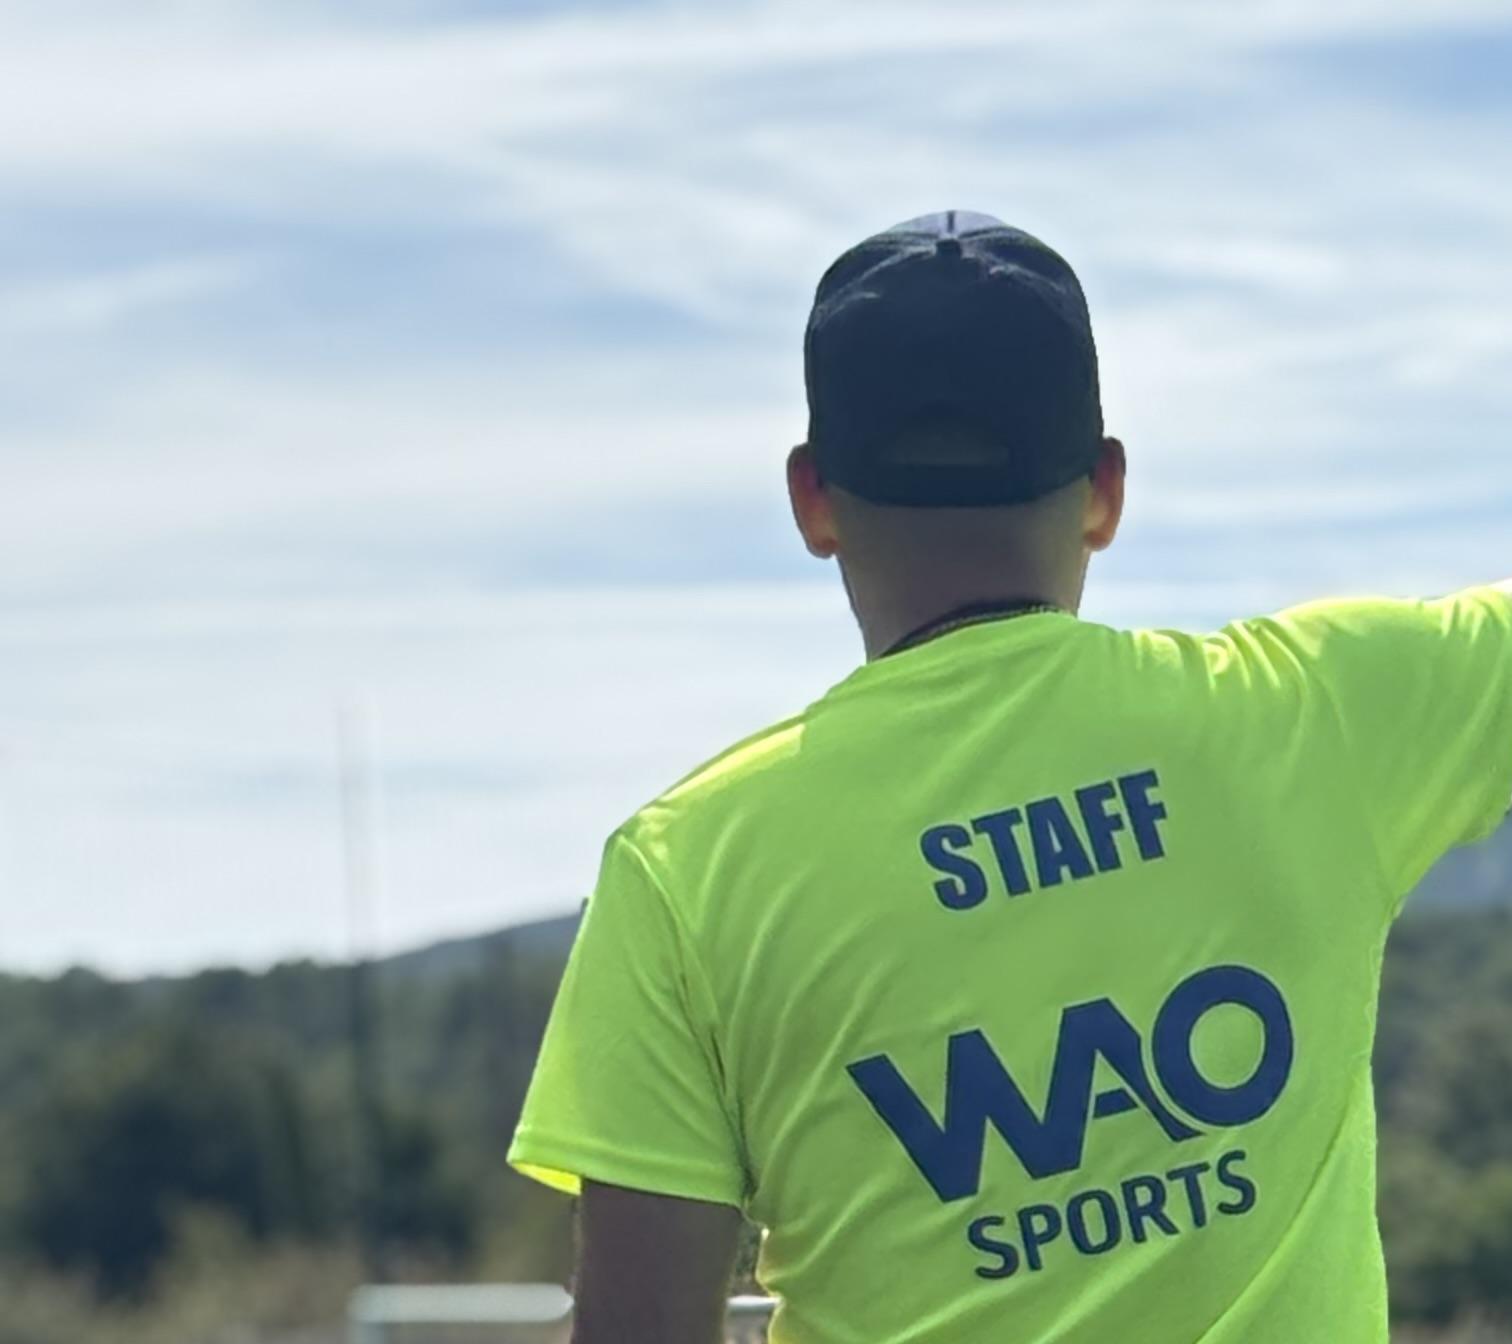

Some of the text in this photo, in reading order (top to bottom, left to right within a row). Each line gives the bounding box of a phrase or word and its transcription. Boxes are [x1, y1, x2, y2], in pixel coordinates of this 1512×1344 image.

[920, 769, 1168, 911] STAFF
[846, 964, 1295, 1204] WAO
[967, 1150, 1257, 1280] SPORTS
